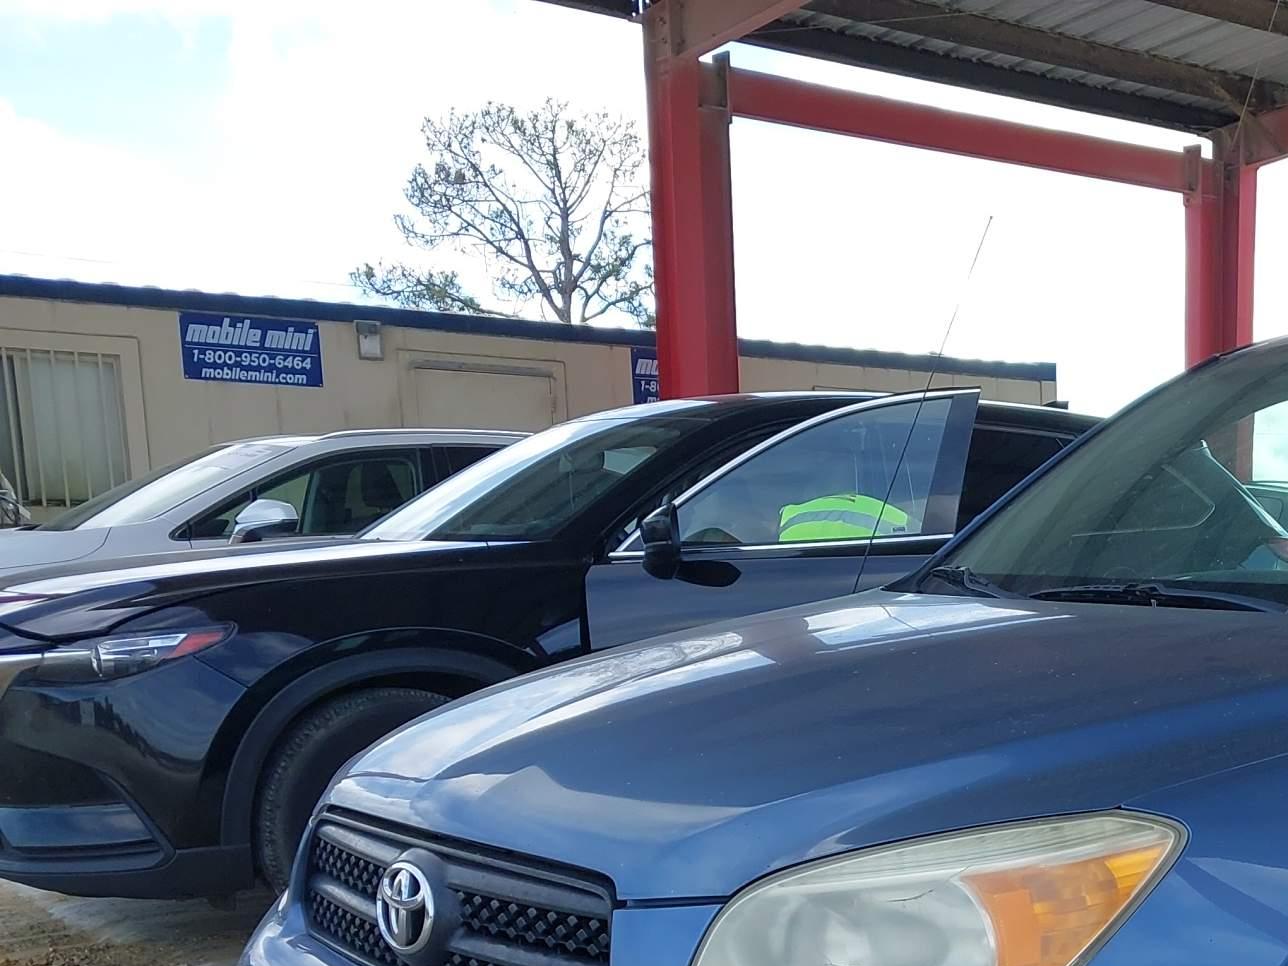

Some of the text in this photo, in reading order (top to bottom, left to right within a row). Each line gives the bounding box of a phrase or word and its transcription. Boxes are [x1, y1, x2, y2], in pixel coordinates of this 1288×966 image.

[185, 317, 314, 351] mobile mini
[192, 349, 312, 370] 1-800-950-6464
[201, 366, 307, 384] mobilemini.com
